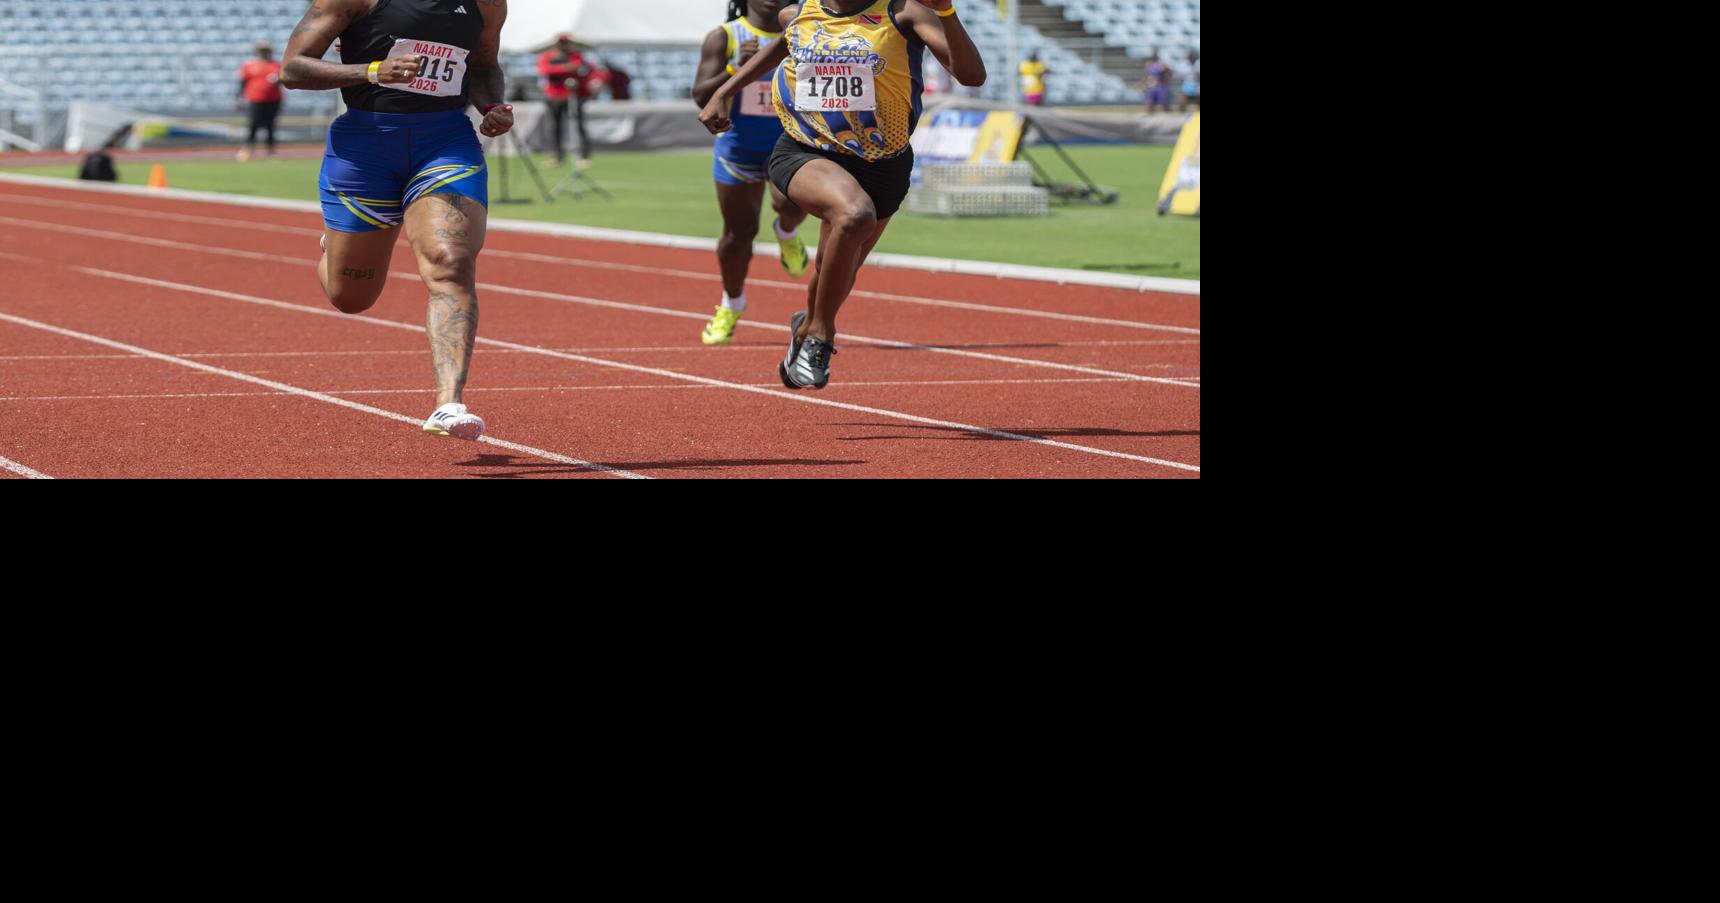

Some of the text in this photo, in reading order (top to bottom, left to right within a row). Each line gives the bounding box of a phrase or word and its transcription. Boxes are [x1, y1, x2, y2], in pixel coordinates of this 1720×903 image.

[413, 42, 454, 59] NAAATT
[415, 55, 458, 82] 015
[814, 65, 853, 76] NAAATT
[408, 78, 438, 92] 2026
[807, 76, 864, 97] 1708
[821, 98, 849, 109] 2026
